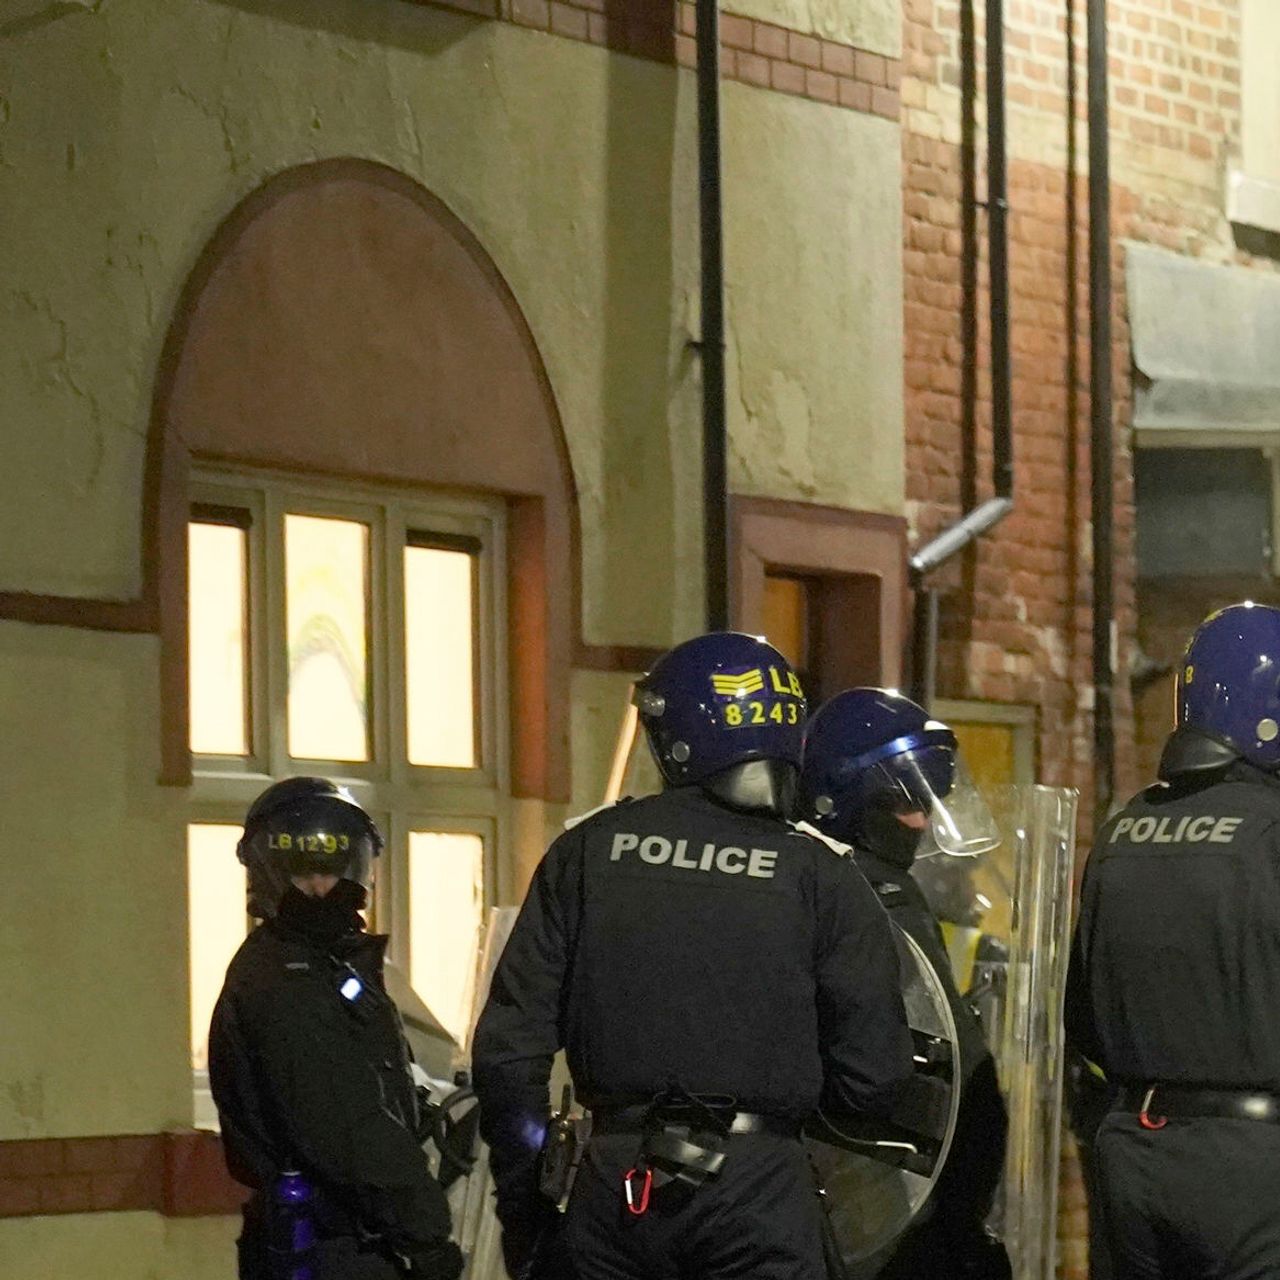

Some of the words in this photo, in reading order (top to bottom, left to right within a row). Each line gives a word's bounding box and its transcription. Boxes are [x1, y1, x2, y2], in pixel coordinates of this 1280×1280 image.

[725, 703, 798, 726] 8243
[1108, 816, 1244, 843] POLICE
[610, 832, 779, 878] POLICE
